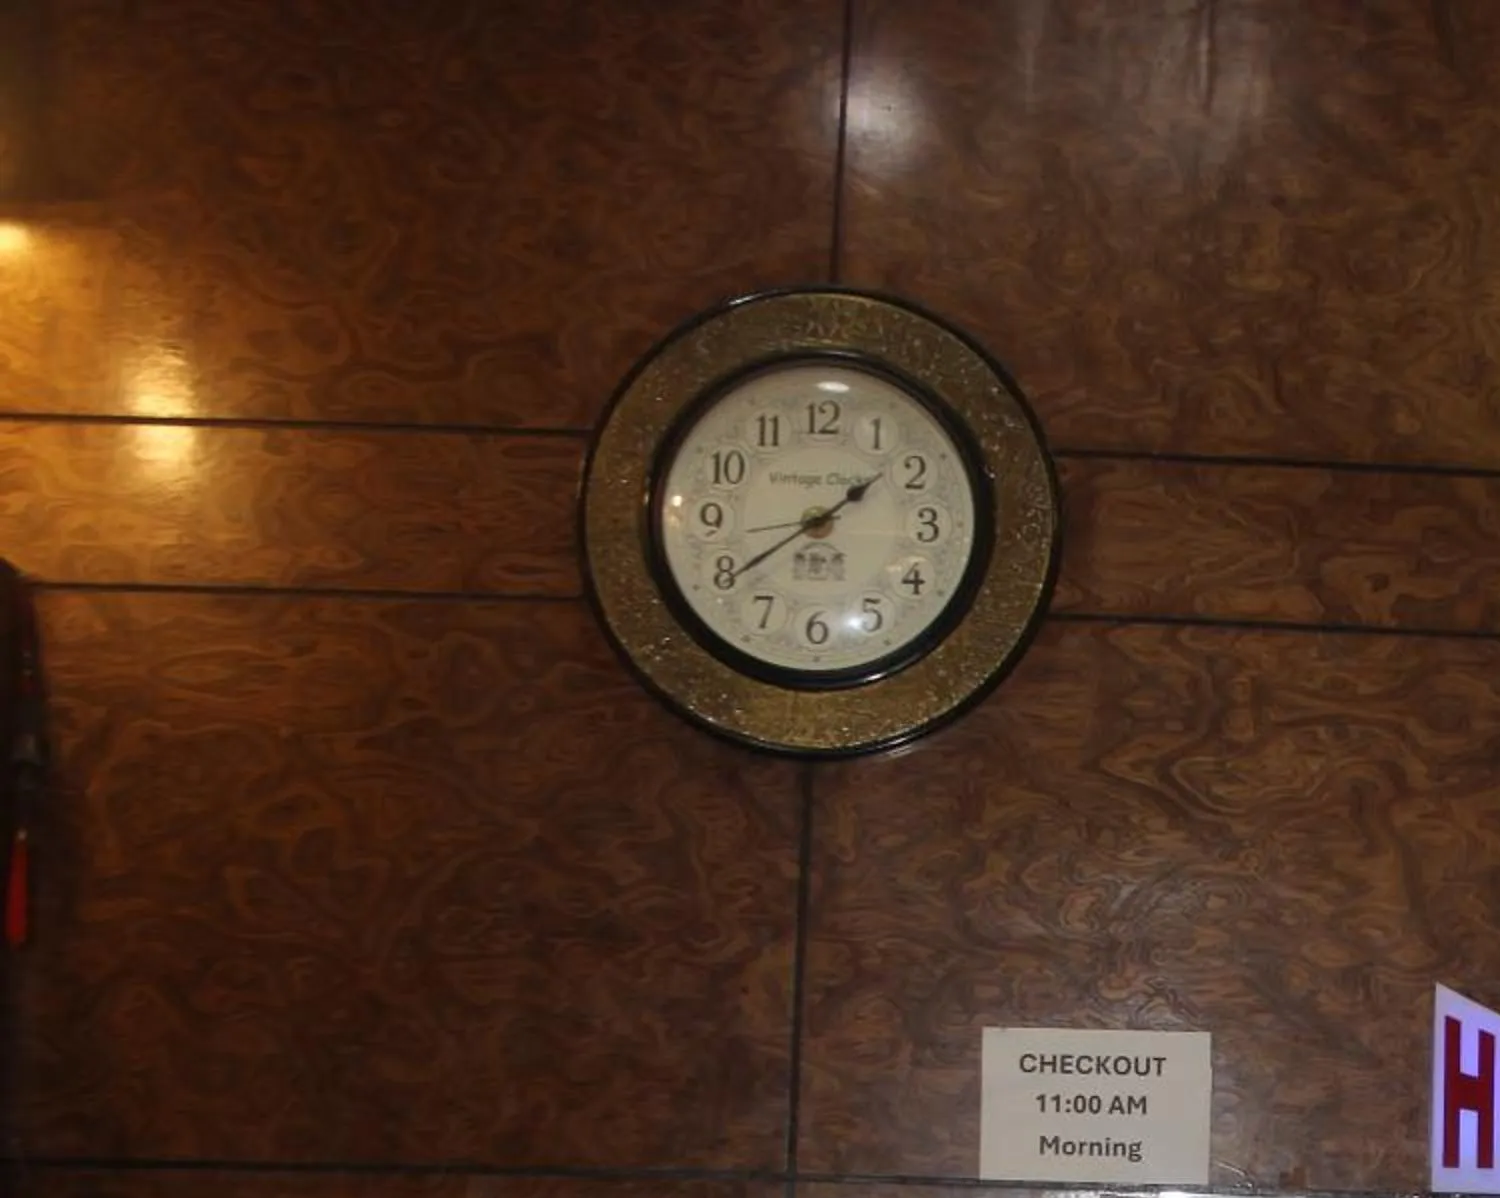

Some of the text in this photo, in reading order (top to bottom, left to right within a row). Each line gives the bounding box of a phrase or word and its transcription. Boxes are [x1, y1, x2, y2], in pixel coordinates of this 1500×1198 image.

[755, 415, 780, 447] 11
[806, 400, 841, 435] 12
[871, 418, 881, 450] 1
[712, 450, 745, 485] 10
[904, 456, 927, 490] 2
[701, 503, 723, 537] 9
[916, 508, 940, 542] 3
[713, 556, 736, 590] 8
[902, 563, 926, 595] 4
[753, 596, 774, 629] 7
[805, 612, 829, 644] 6
[861, 599, 883, 632] 5
[1019, 1053, 1167, 1077] CHECKOUT
[1036, 1094, 1147, 1115] 11:00 AM
[1039, 1135, 1143, 1162] Morning
